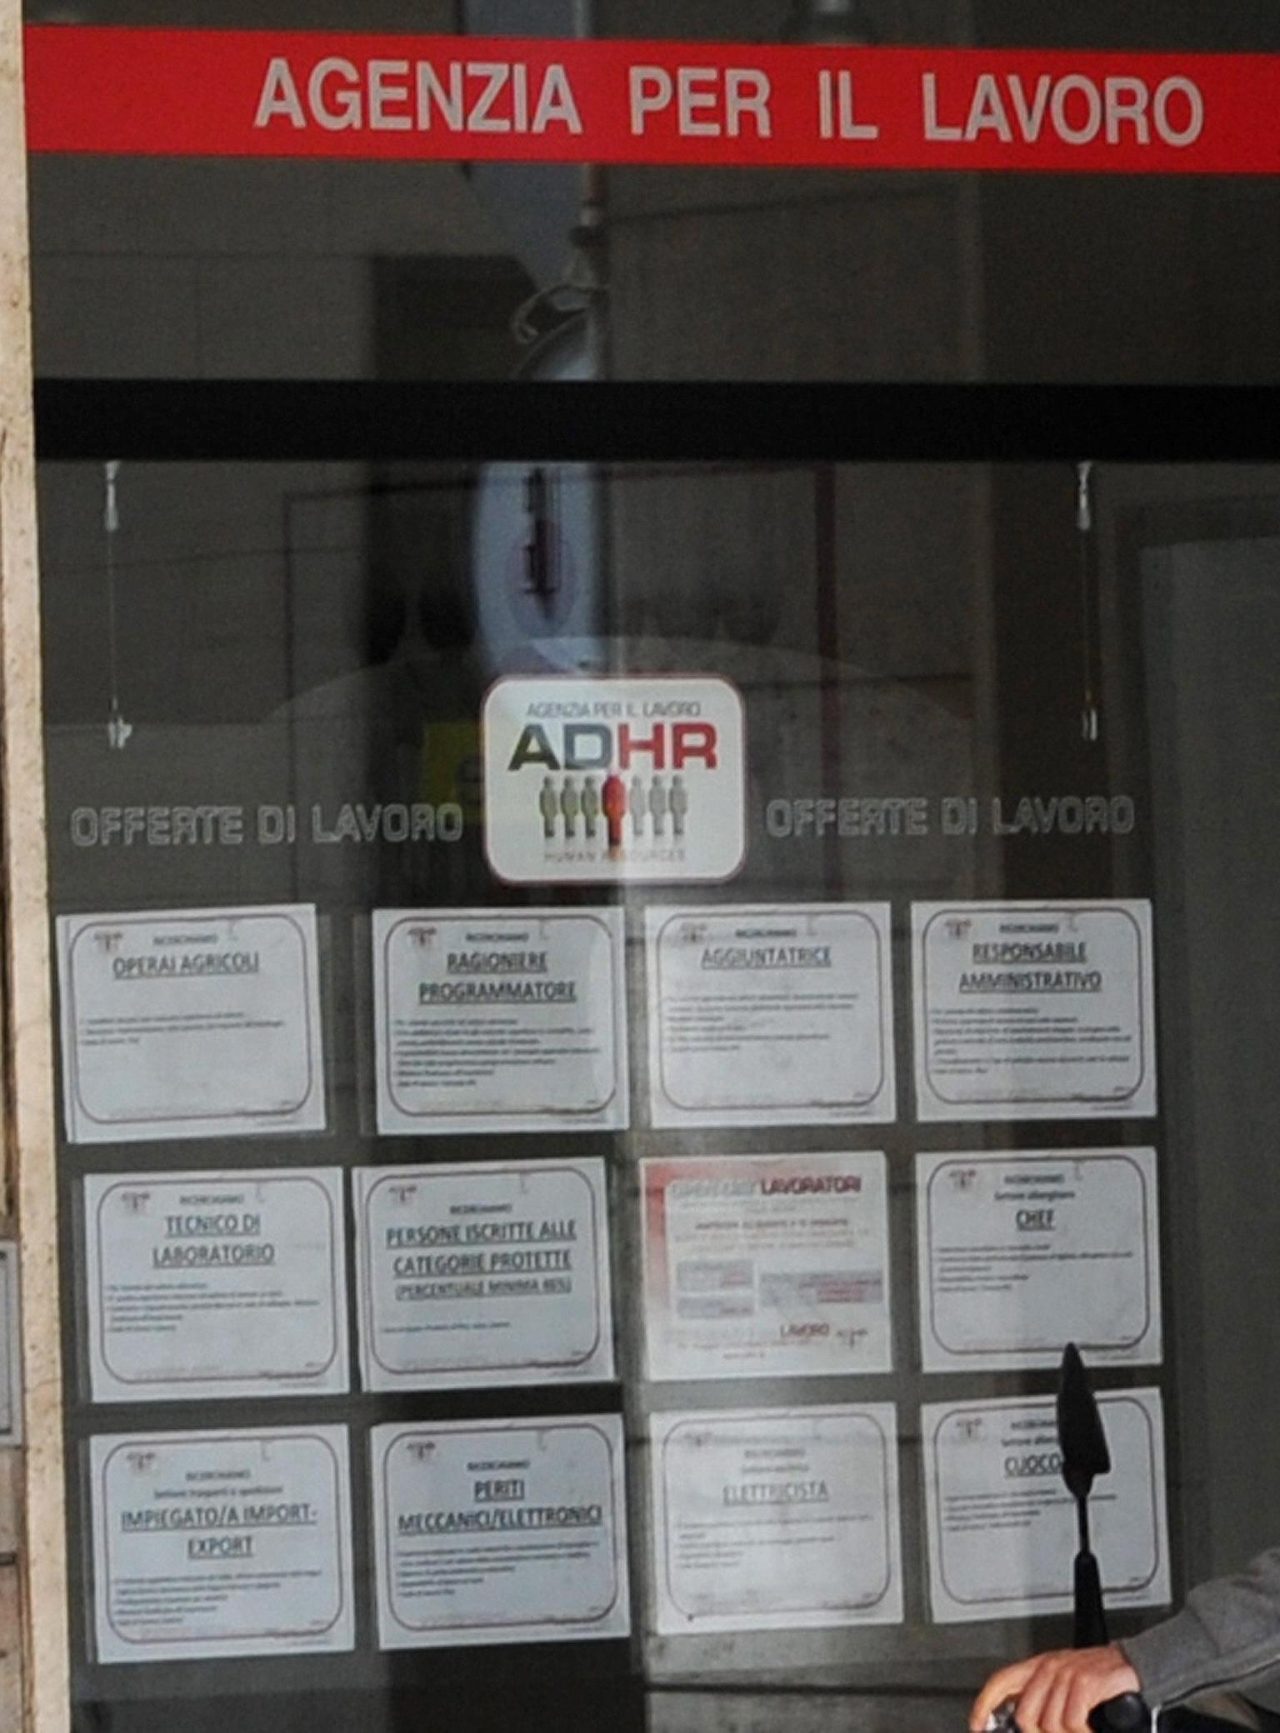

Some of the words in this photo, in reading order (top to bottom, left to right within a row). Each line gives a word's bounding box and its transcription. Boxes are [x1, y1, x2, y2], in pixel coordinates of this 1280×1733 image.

[253, 56, 583, 134] AGENZIA
[629, 66, 772, 139] PER
[819, 70, 878, 139] IL
[921, 73, 1203, 146] LAVORO
[527, 702, 591, 718] AGENZIA
[594, 701, 623, 717] PER
[643, 700, 701, 717] LAVORO
[508, 722, 718, 771] ADHR
[70, 805, 243, 846] OFFERTE
[257, 805, 296, 844] DI
[312, 803, 464, 843] LAVORO
[765, 797, 927, 838] OFFERTE
[941, 797, 976, 833] DI
[993, 795, 1134, 834] LAVORO
[112, 955, 176, 978] OPERAI
[180, 952, 259, 976] AGRICOLI
[447, 952, 548, 973] RAGIONIERE
[972, 942, 1087, 963] RESPONSABILE
[419, 981, 577, 1003] PROGRAMMATORE
[959, 970, 1102, 993] AMMINISTRATIVO
[760, 1175, 862, 1196] LAVORATORI
[164, 1214, 239, 1237] TECNICO
[243, 1213, 260, 1236] DI
[1016, 1209, 1056, 1231] CHEF
[386, 1225, 460, 1248] PERSONE
[465, 1221, 533, 1244] ISCRITTE
[538, 1219, 577, 1241] ALLE
[152, 1243, 275, 1268] LABORATORIO
[393, 1253, 484, 1278] CATEGORIE
[490, 1249, 572, 1272] PROTETTE
[1004, 1453, 1063, 1479] CUOCO
[474, 1479, 525, 1502] PERITI
[723, 1480, 829, 1506] ELETTRICISTA
[121, 1505, 239, 1532] IMPIEGATO/A
[243, 1502, 317, 1526] IMPORT-
[398, 1505, 602, 1536] MECCANICI/ELETTRONICI
[188, 1535, 252, 1560] EXPORT
